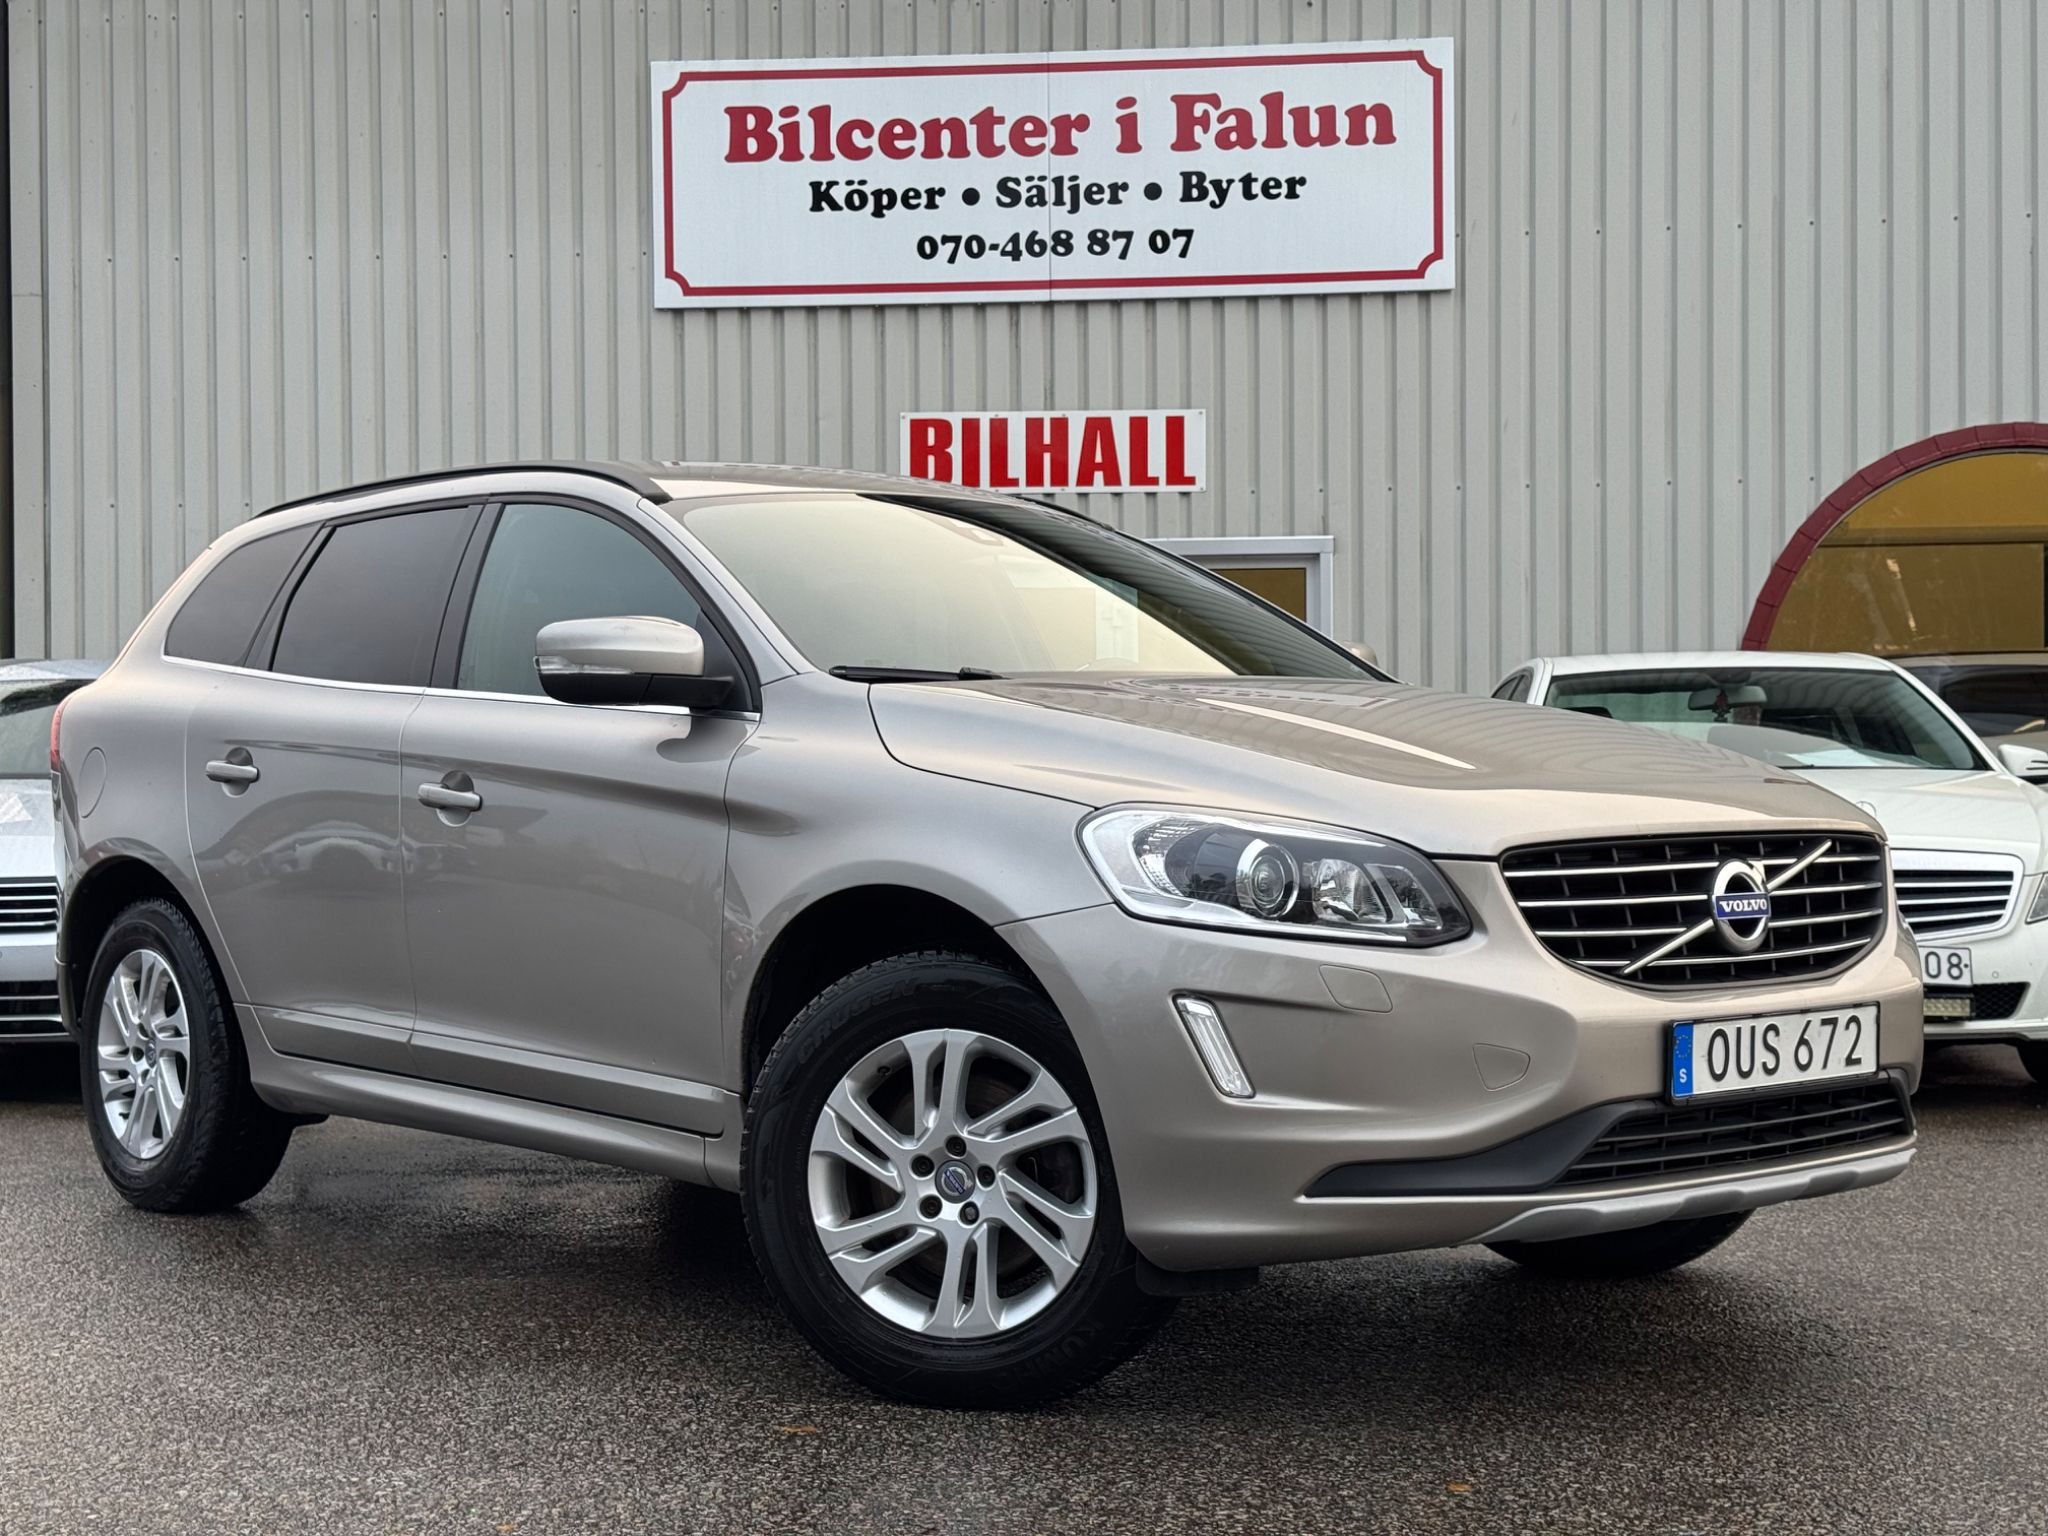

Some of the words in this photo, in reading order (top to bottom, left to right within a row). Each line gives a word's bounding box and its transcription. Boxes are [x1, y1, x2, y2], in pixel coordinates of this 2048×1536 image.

[724, 105, 1090, 163] Bilcenter
[1117, 97, 1141, 153] i
[1170, 92, 1397, 152] Falun
[809, 180, 946, 219] Köper
[996, 176, 1129, 214] Säljer
[1180, 170, 1307, 209] Byter
[916, 229, 1074, 264] 070-468
[1087, 229, 1134, 260] 87
[1148, 228, 1195, 259] 07
[910, 416, 1196, 487] BILHALL
[1718, 898, 1769, 914] VOLVO
[1707, 1022, 1782, 1082] OUS
[1793, 1014, 1863, 1072] 672
[1679, 1069, 1687, 1083] S
